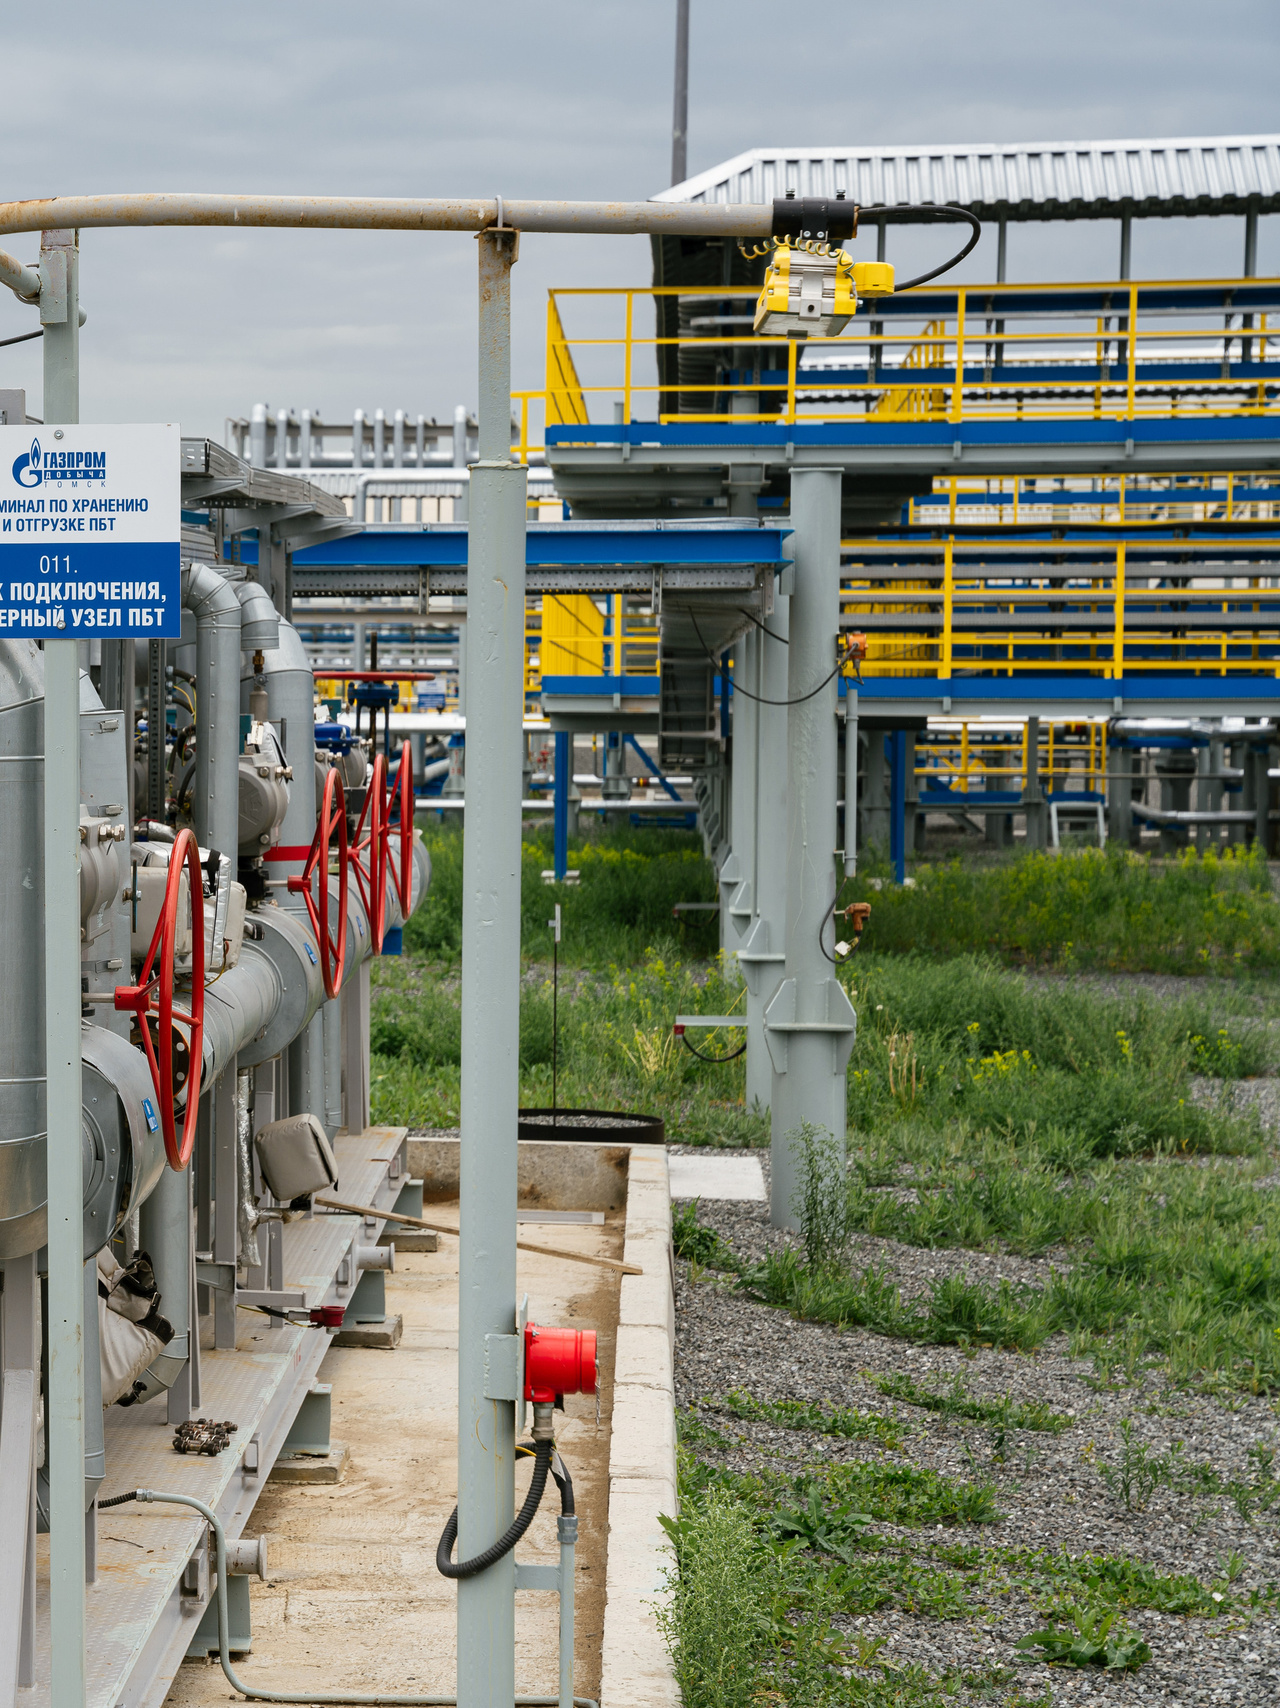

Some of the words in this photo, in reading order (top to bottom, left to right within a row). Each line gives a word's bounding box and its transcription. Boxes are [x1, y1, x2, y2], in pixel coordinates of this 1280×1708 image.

[43, 451, 106, 469] ГАЗПРОМ
[45, 470, 105, 480] ДОБЫЧА
[43, 480, 106, 488] ТОМСК
[49, 499, 68, 513] ПО
[71, 498, 149, 513] ХРАНЕНИЮ
[2, 518, 12, 532] И
[15, 517, 85, 532] ОТГРУЗКЕ
[89, 517, 116, 532] ПБТ
[39, 555, 79, 574] 011.
[10, 581, 168, 604] ПОДКЛЮЧЕНИЯ,
[71, 608, 122, 627] УЗЕЛ
[128, 607, 166, 627] ПБТ
